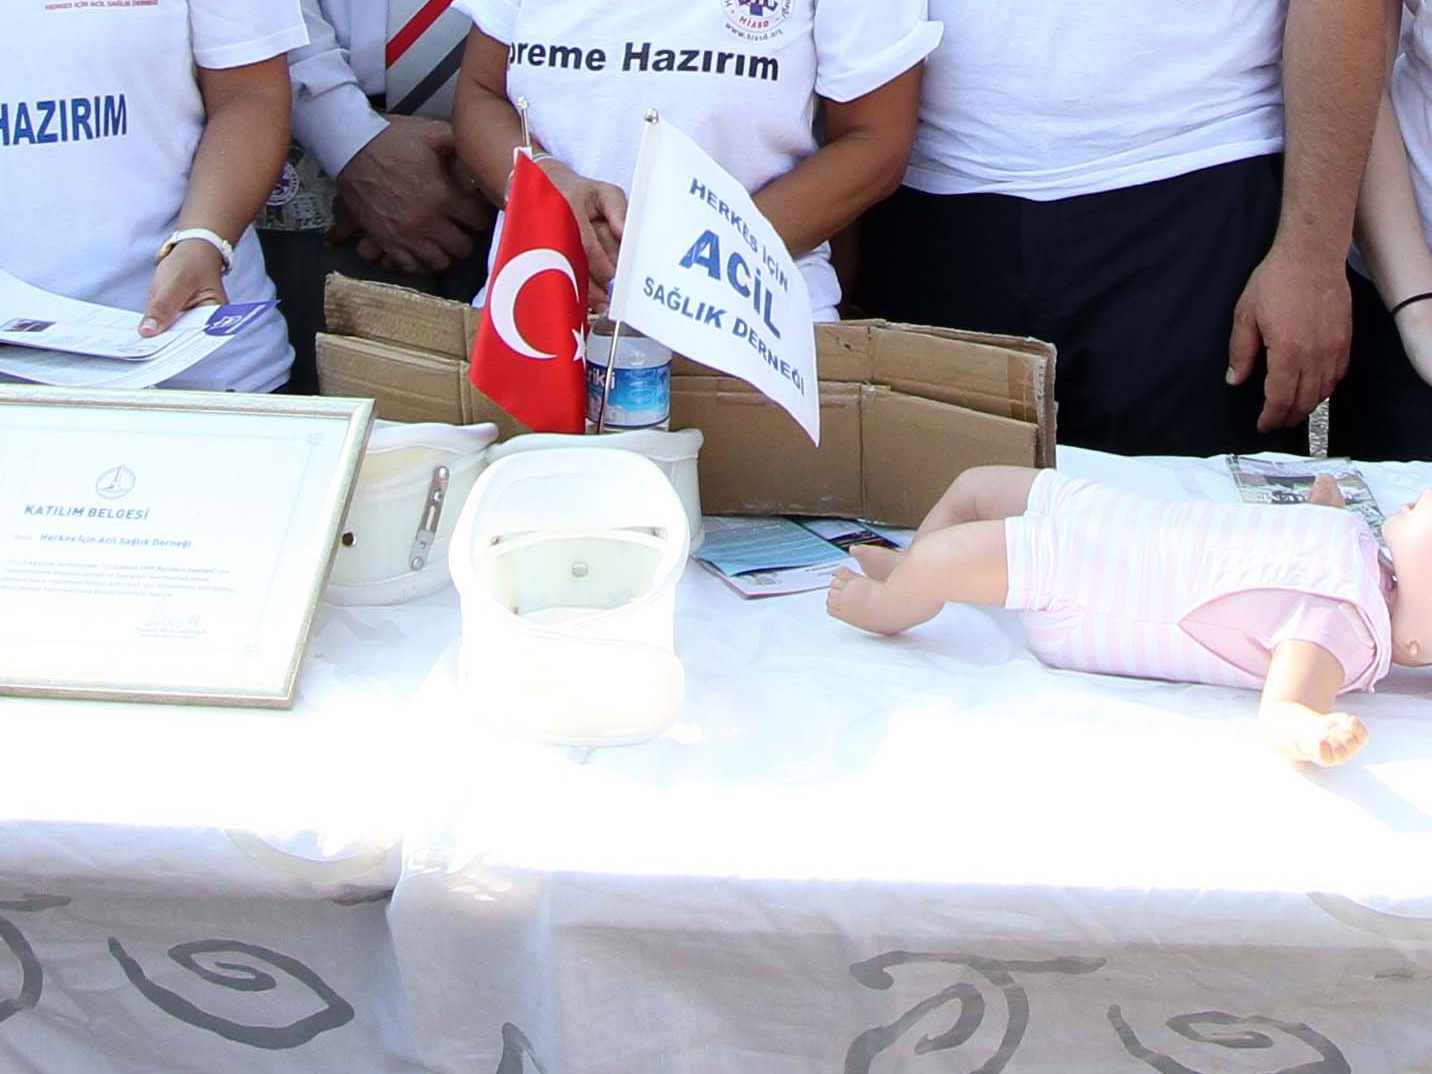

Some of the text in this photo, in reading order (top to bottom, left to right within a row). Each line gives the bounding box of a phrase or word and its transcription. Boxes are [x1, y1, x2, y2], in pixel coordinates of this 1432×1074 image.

[621, 41, 780, 82] Hazırım
[678, 228, 781, 340] ACİL
[689, 177, 789, 293] HERKES İÇİN
[642, 276, 806, 397] SAĞLIK DERNEĞİ
[23, 504, 150, 521] KATILIM BELGESİ
